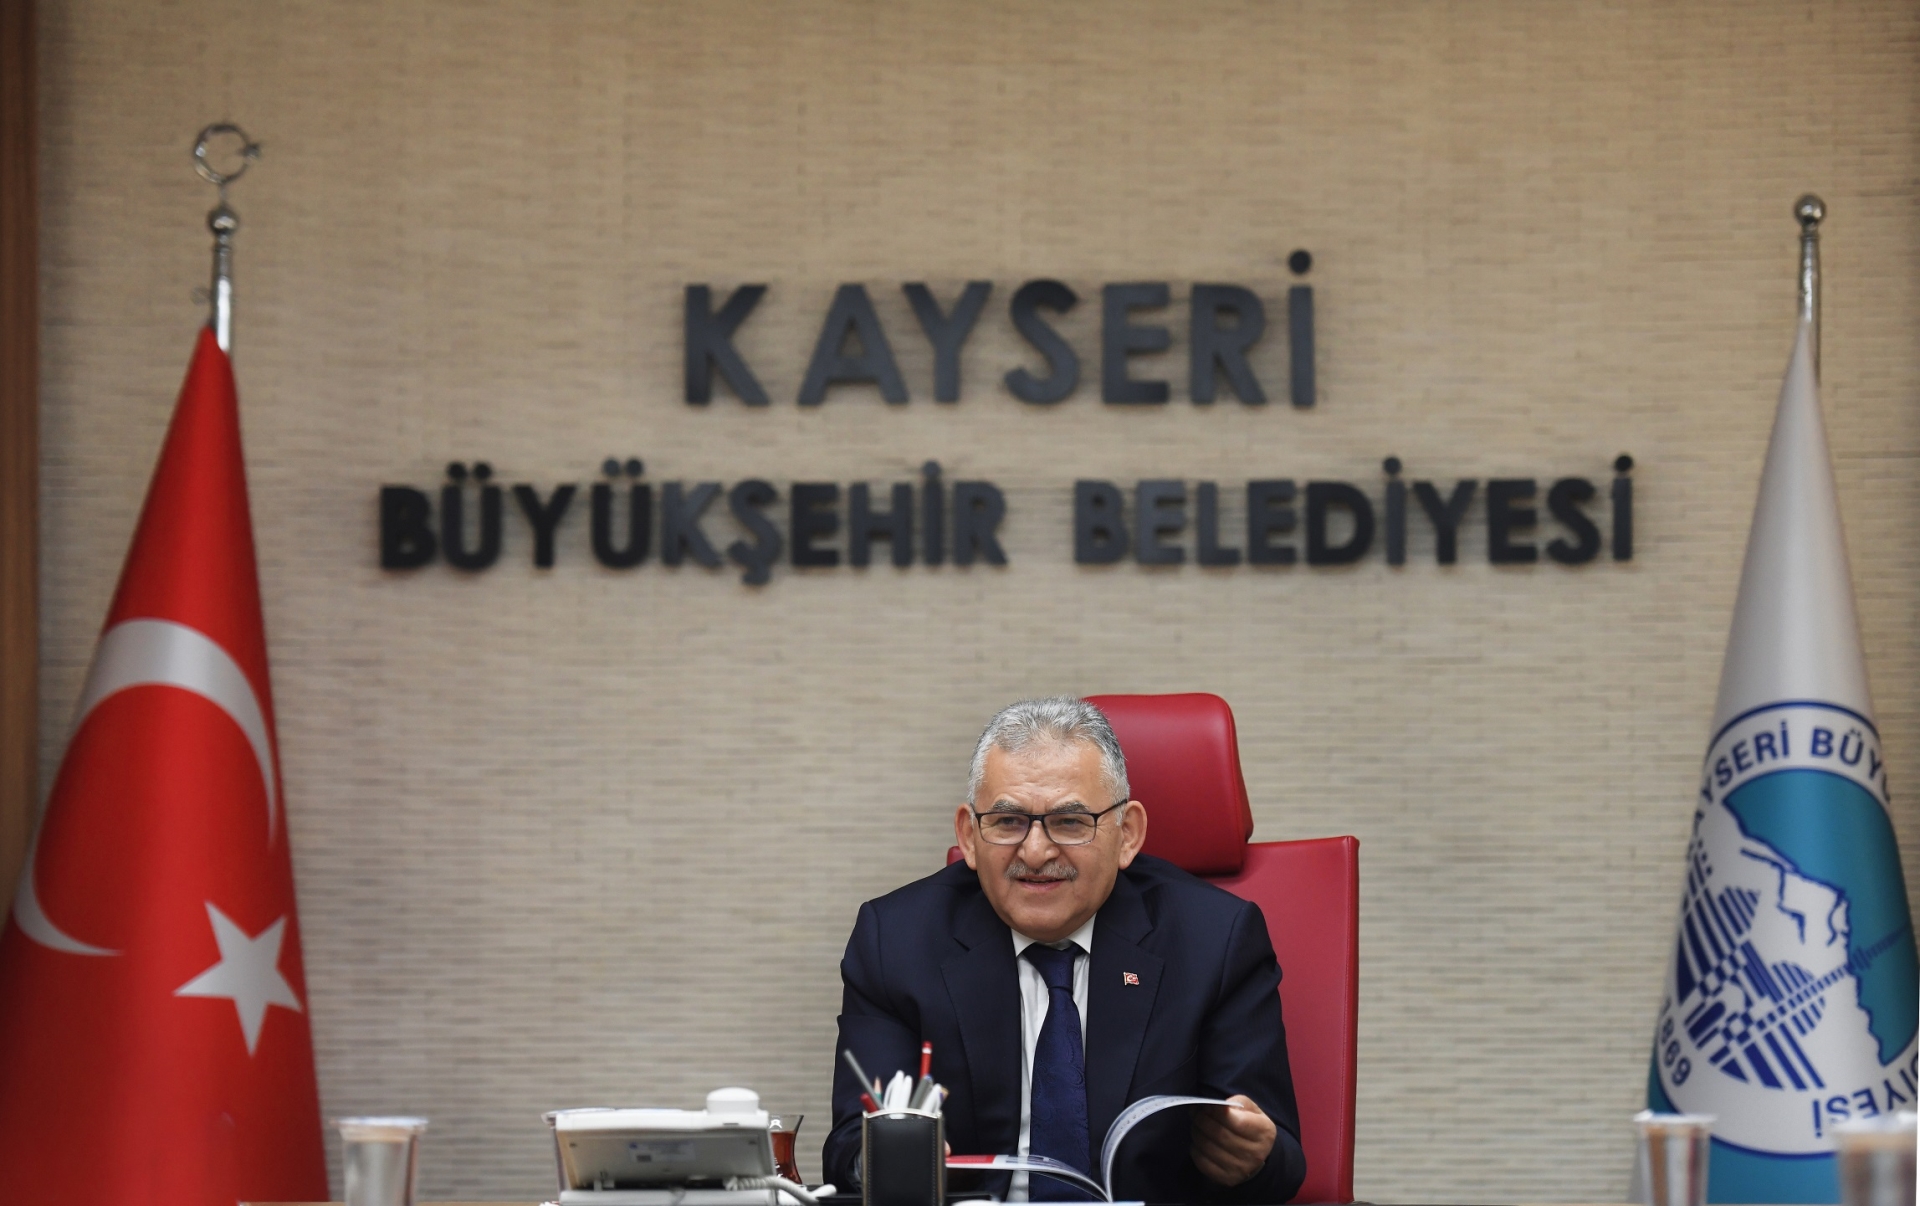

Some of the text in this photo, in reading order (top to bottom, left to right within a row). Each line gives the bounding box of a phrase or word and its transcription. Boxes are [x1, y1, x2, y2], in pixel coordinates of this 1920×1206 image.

[683, 249, 1317, 407] KAYSERİ
[378, 454, 1635, 587] BÜYÜKŞEHİR BELEDİYESİ
